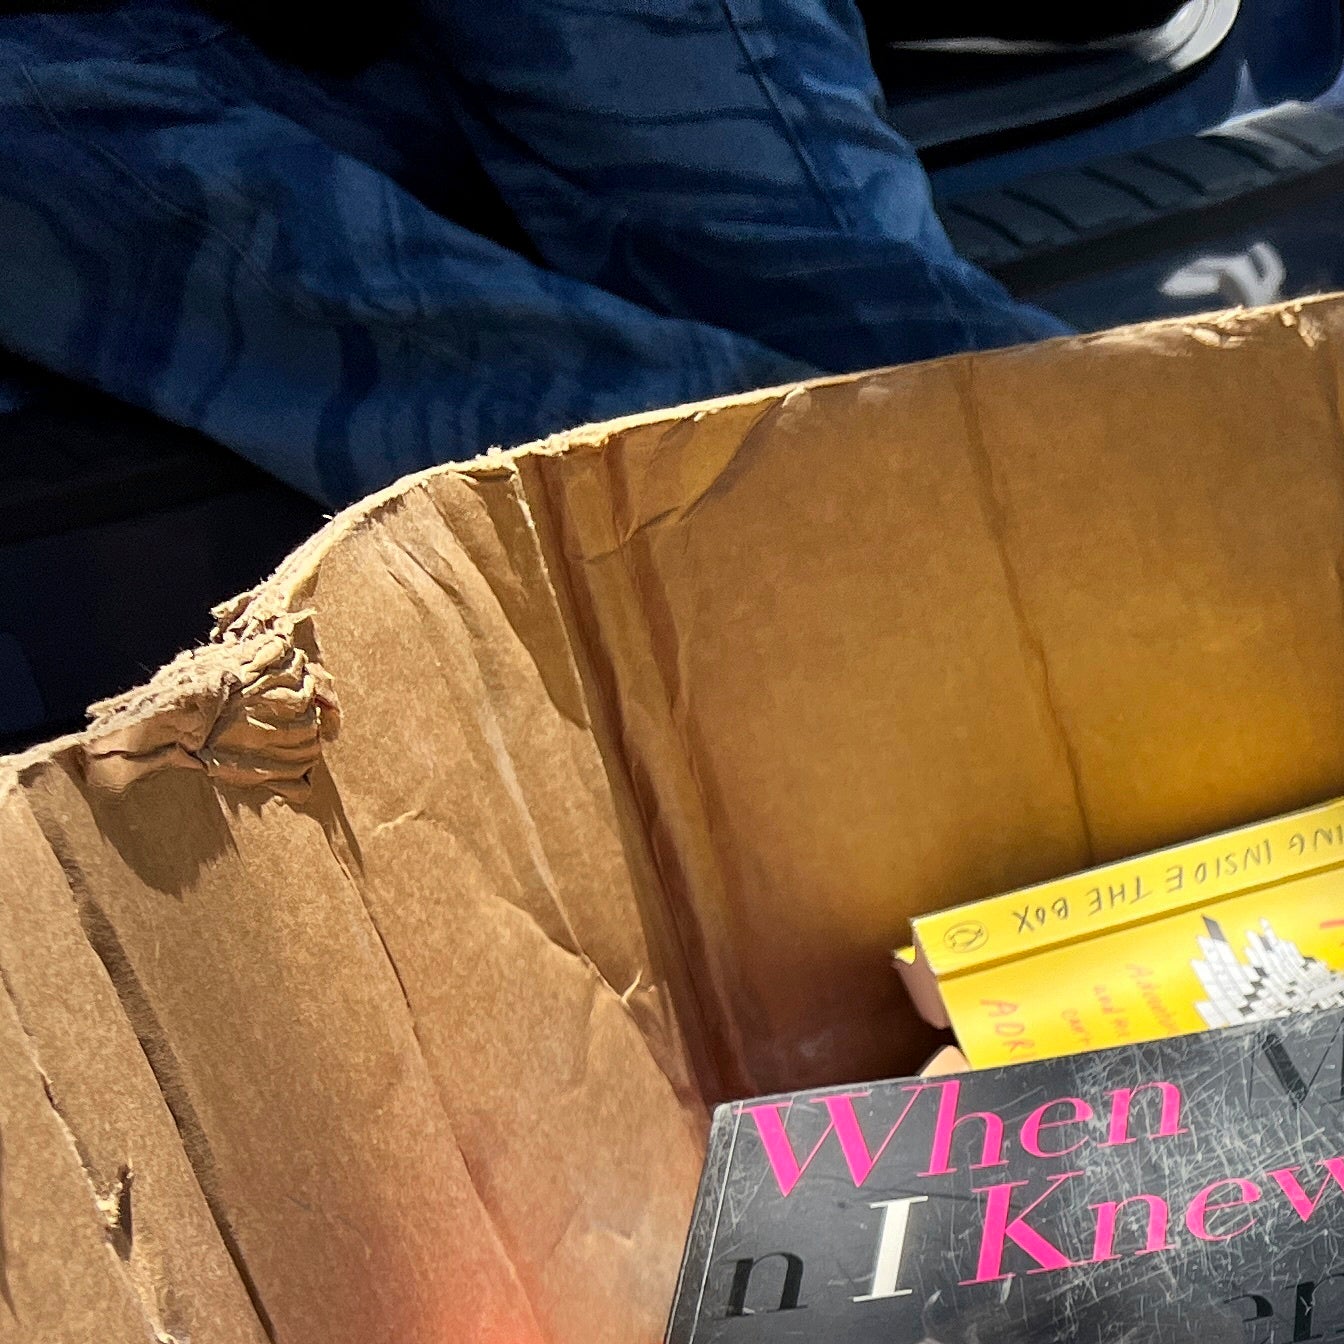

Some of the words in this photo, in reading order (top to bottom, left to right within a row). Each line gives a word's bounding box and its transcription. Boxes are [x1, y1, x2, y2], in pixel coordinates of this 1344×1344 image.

[1161, 838, 1273, 893] INSIDE
[1010, 895, 1071, 936] BOX
[1081, 871, 1151, 916] THE
[738, 1078, 1189, 1200] When
[853, 1195, 928, 1303] I
